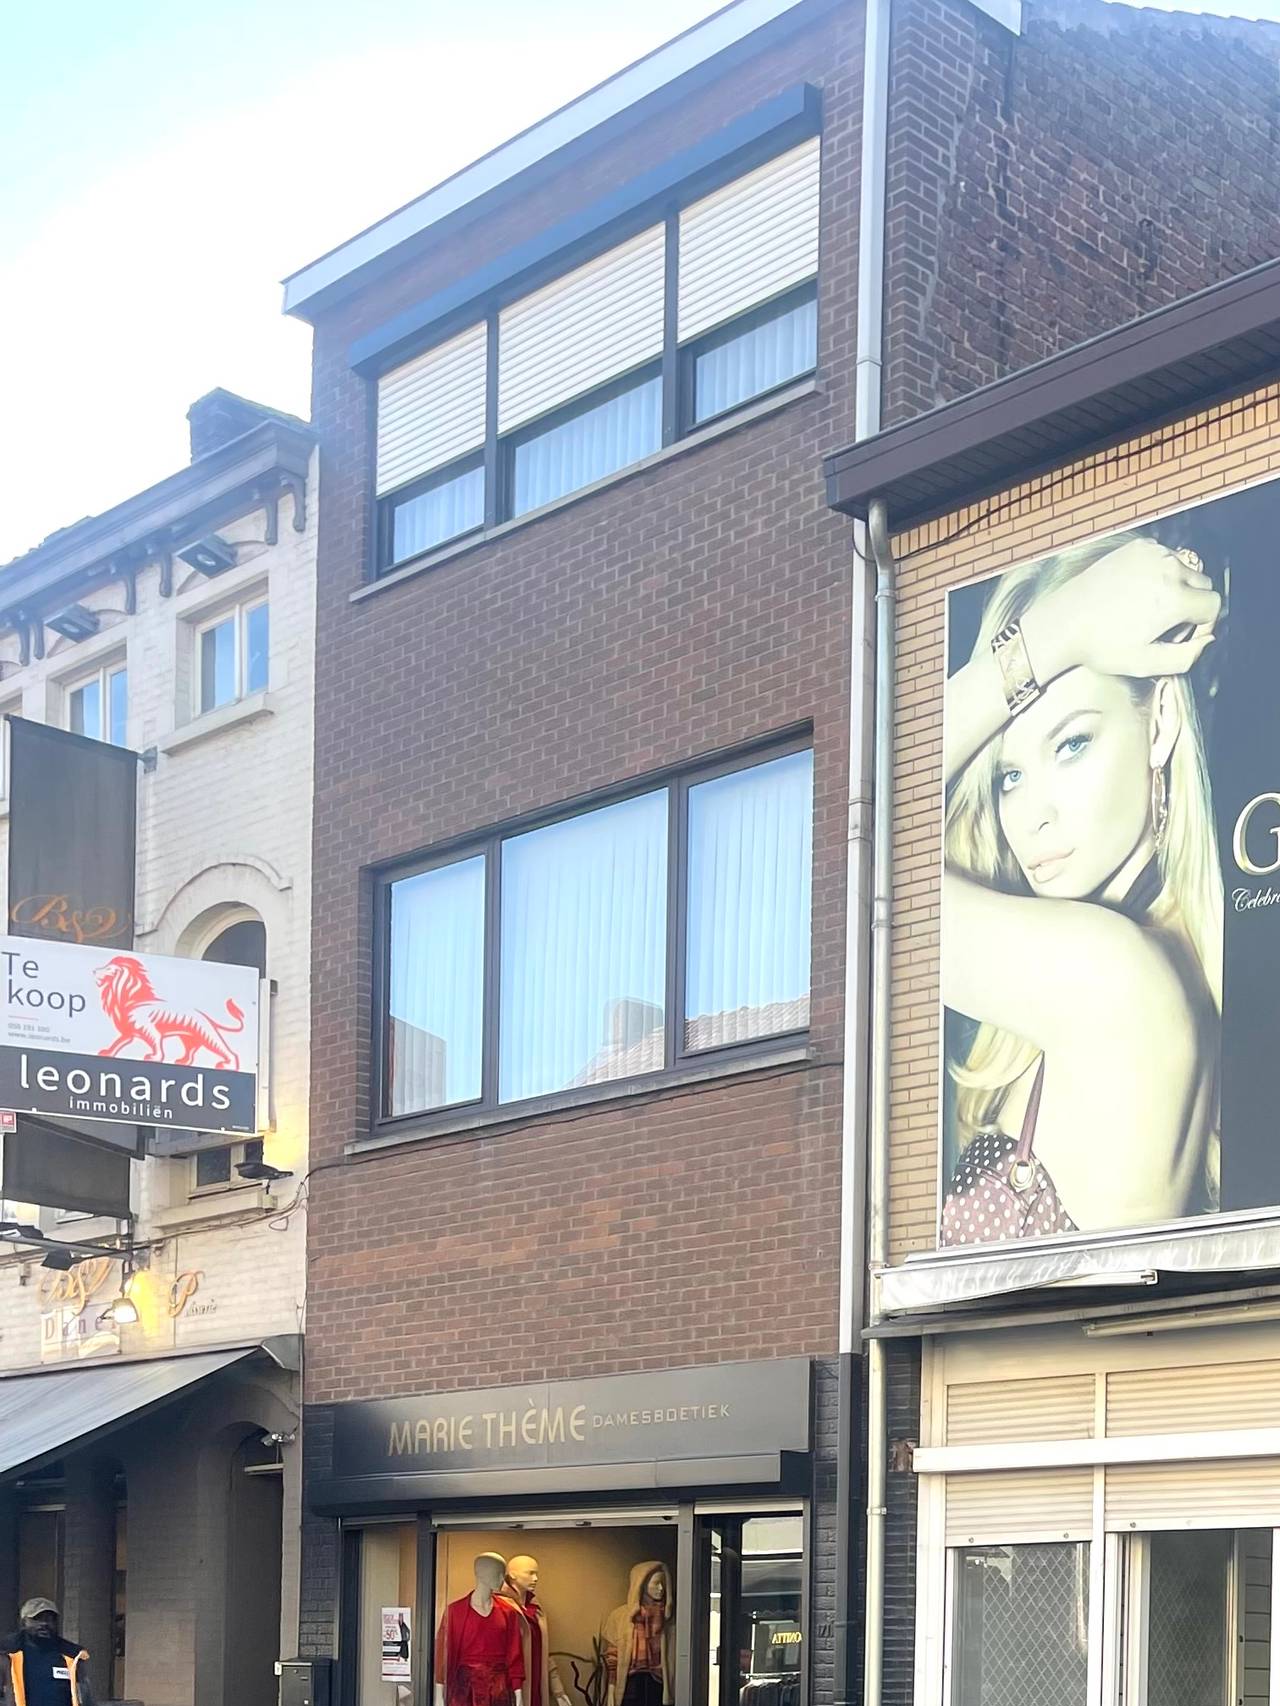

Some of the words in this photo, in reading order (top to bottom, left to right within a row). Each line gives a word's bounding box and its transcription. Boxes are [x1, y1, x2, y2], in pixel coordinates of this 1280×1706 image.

[1, 951, 39, 979] Te
[8, 978, 86, 1018] koop
[20, 1054, 231, 1110] leonards
[69, 1096, 173, 1119] immobiliën
[389, 1415, 473, 1457] MARIE
[482, 1398, 586, 1449] THÈME
[592, 1404, 731, 1430] DAMESBOETIEK
